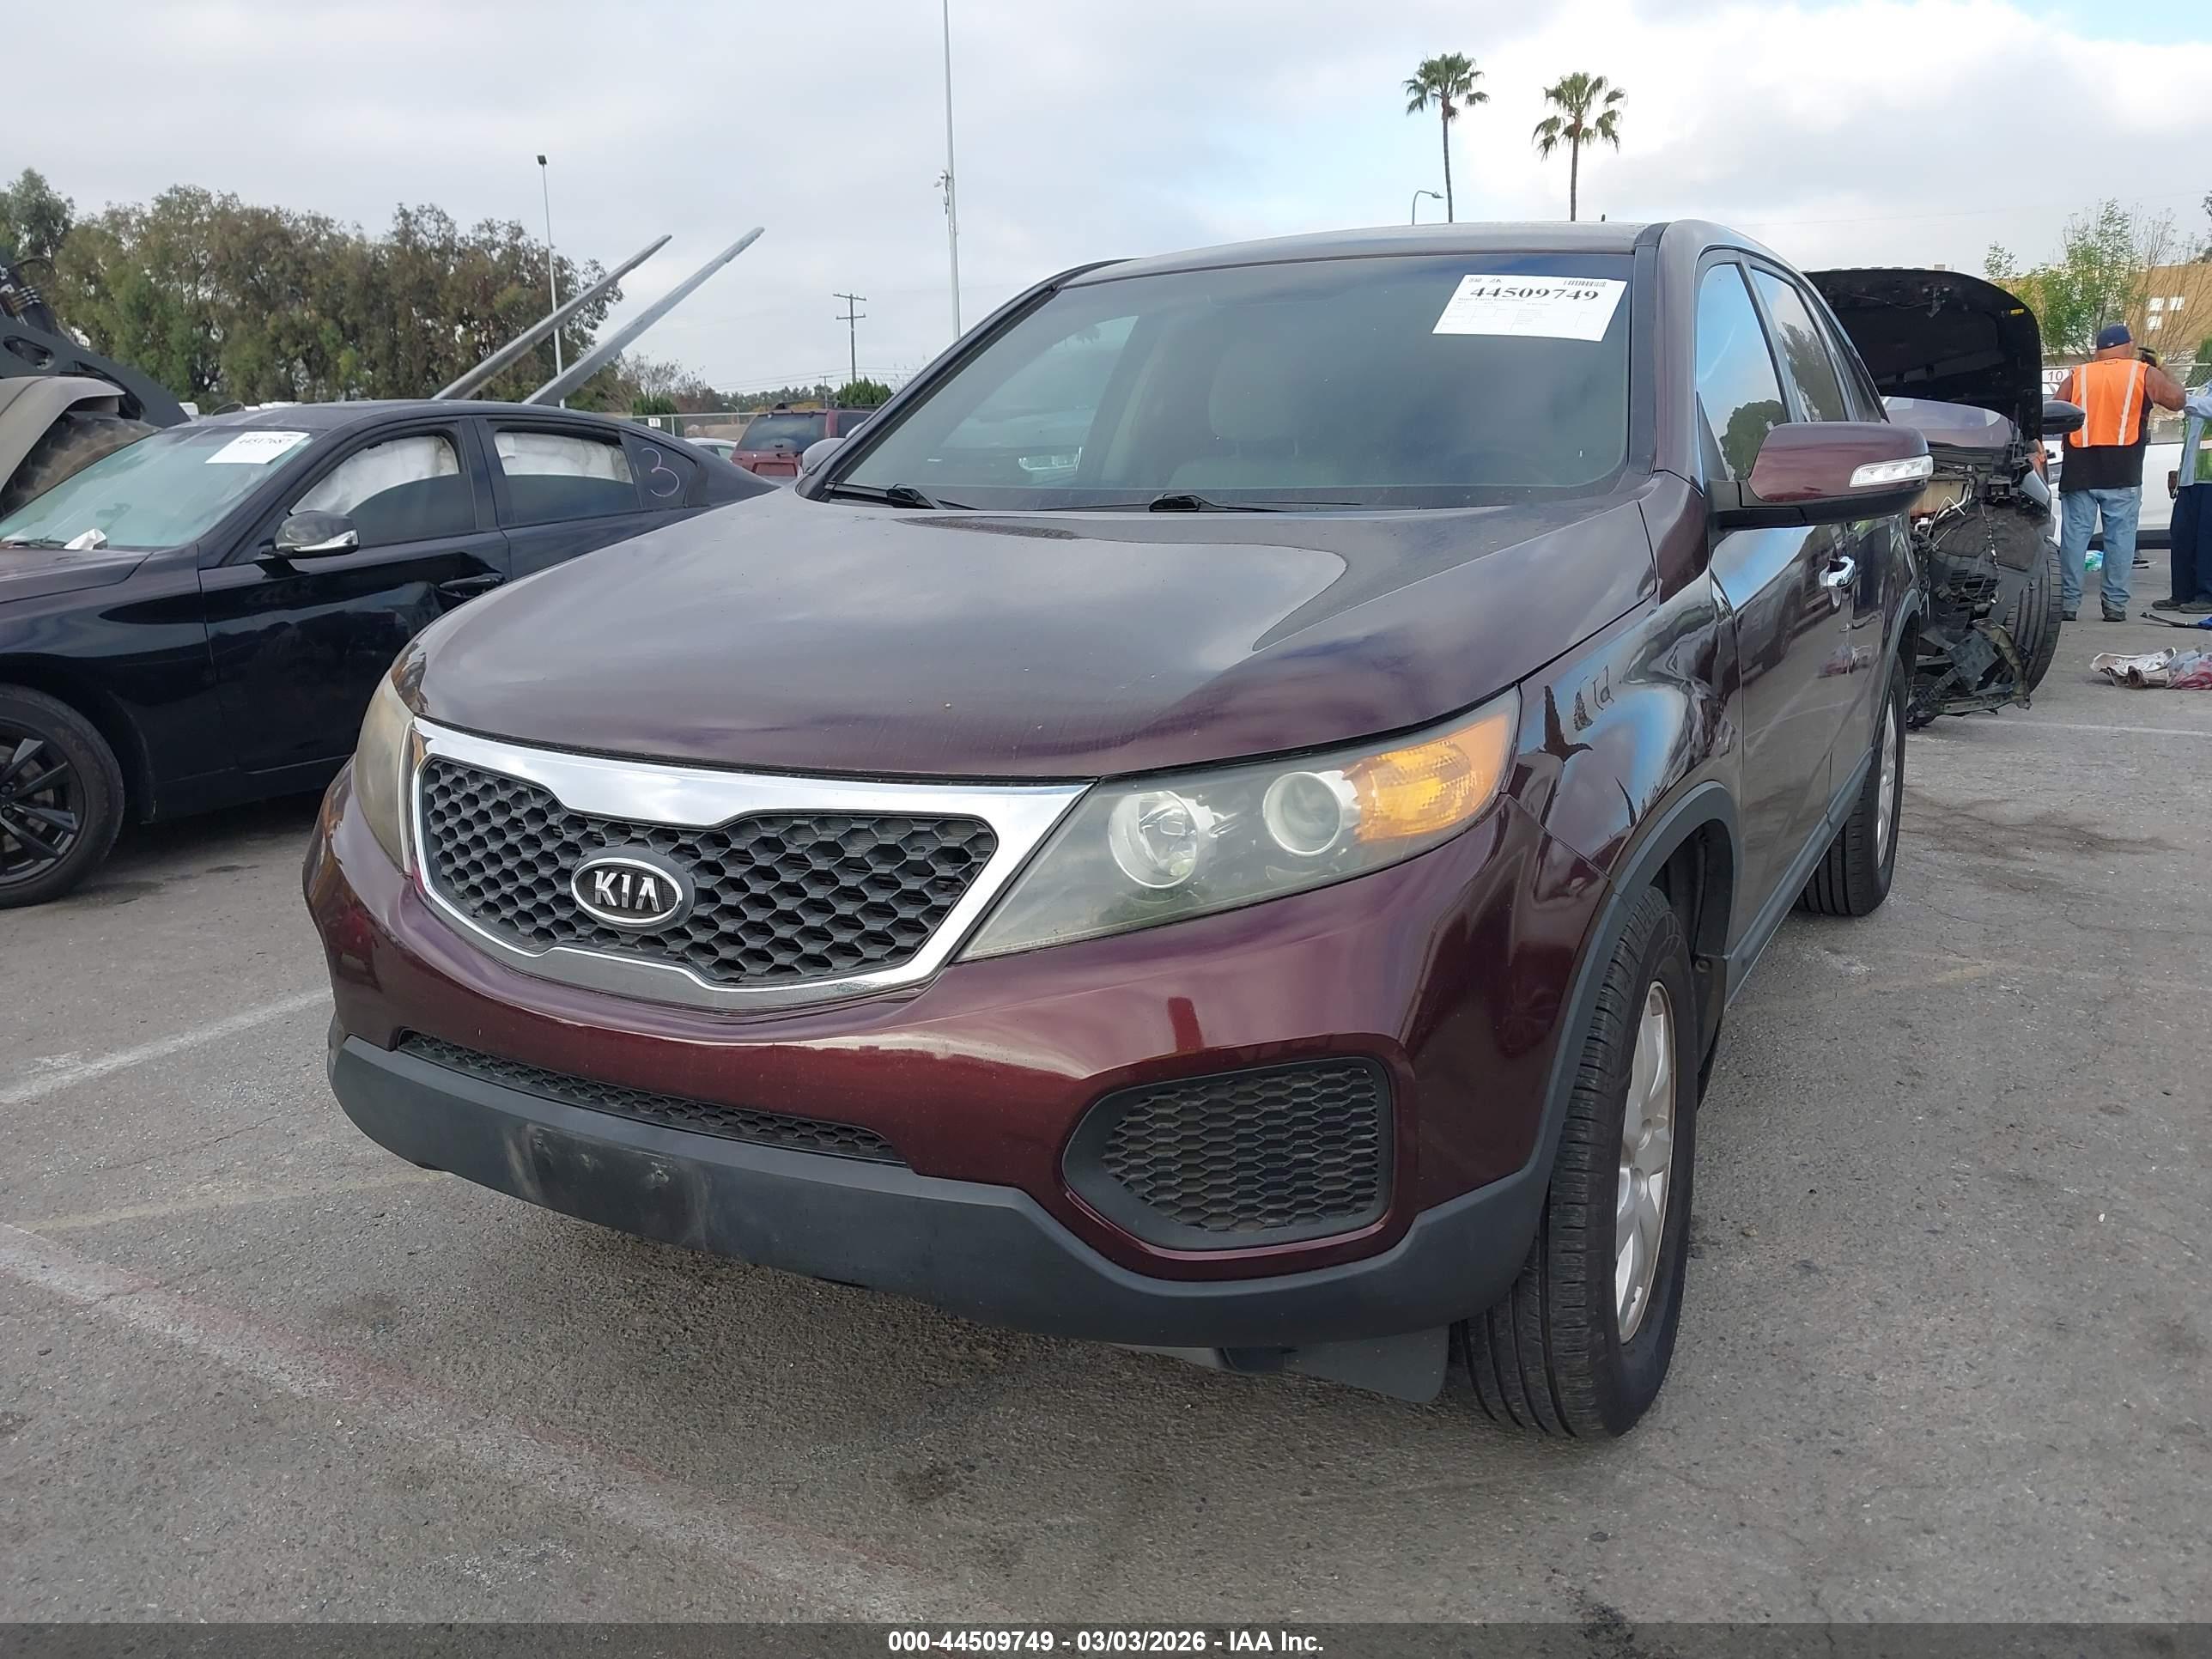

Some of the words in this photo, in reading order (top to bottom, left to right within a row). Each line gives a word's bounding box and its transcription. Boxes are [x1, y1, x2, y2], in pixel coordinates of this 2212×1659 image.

[1469, 286, 1600, 301] 44509749
[2048, 370, 2063, 381] 10
[641, 447, 679, 497] 3
[594, 870, 660, 912] KIA
